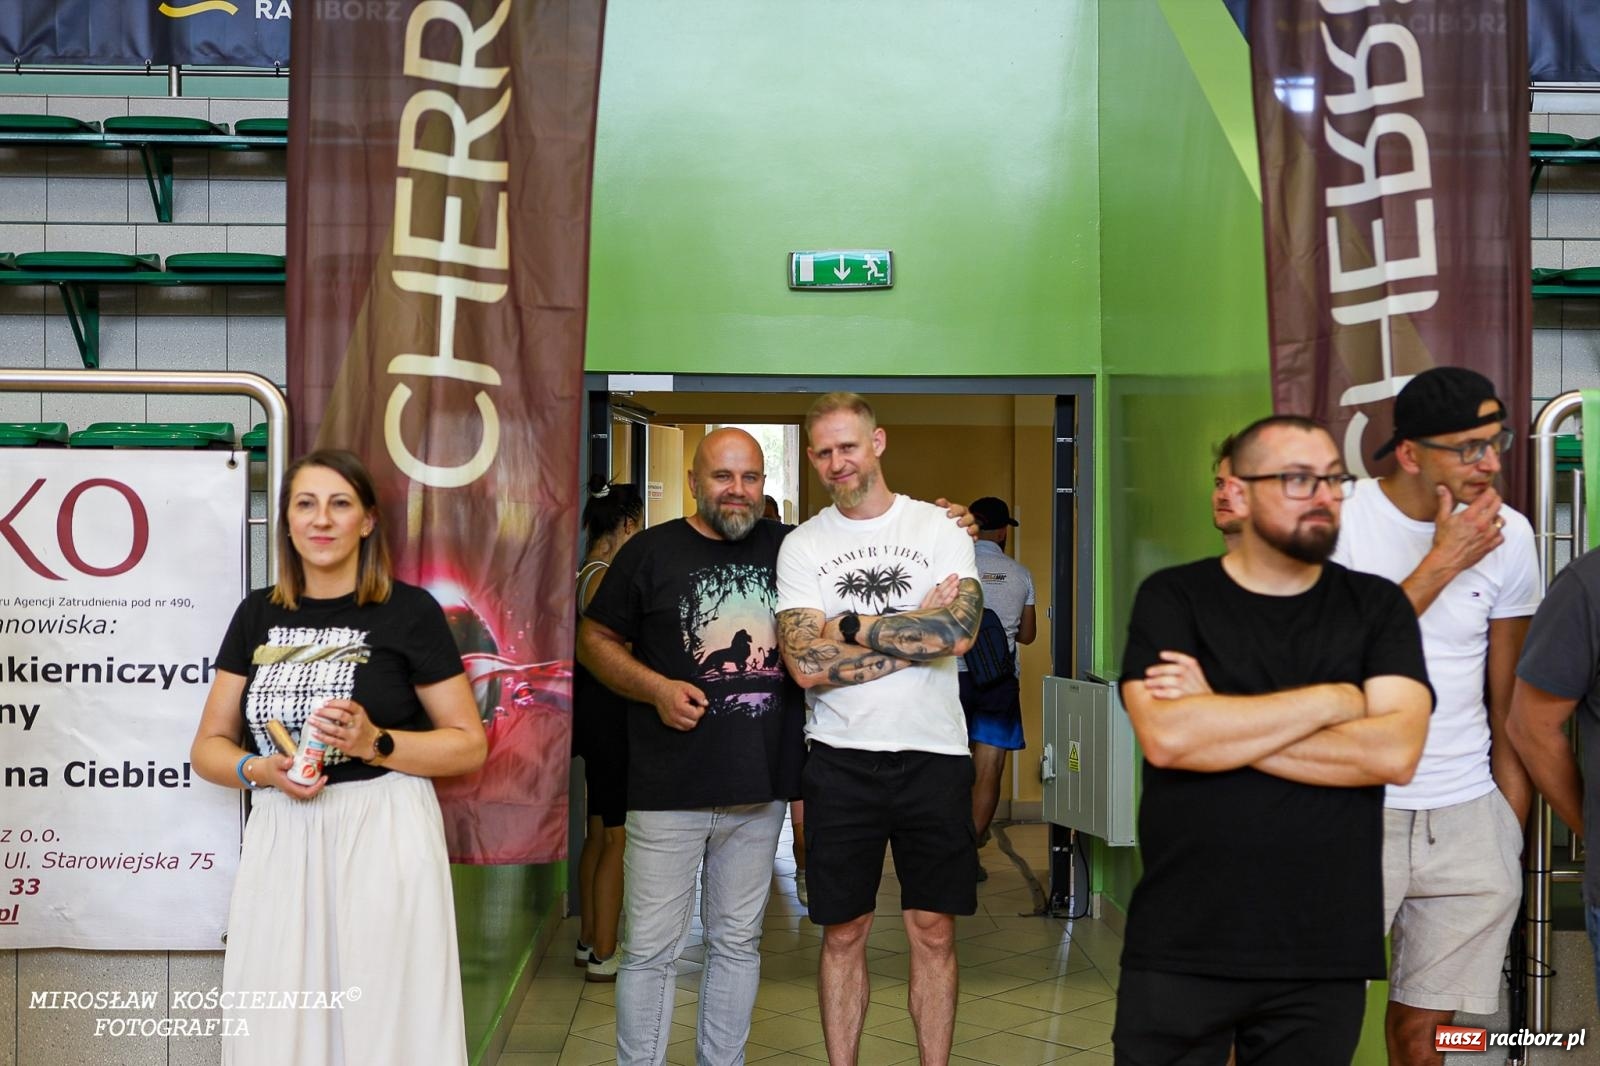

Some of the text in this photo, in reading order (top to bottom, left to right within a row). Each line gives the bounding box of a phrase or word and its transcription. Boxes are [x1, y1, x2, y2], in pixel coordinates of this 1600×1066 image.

[13, 597, 55, 608] Agencji
[58, 597, 128, 607] Zatrudnienia
[131, 597, 151, 608] pod
[155, 599, 167, 607] nr
[170, 598, 195, 609] 490,
[5, 760, 191, 788] na Ciebie!
[20, 829, 60, 843] o.o.
[4, 851, 216, 874] Ul. Starowiejska 75
[9, 878, 41, 896] 33
